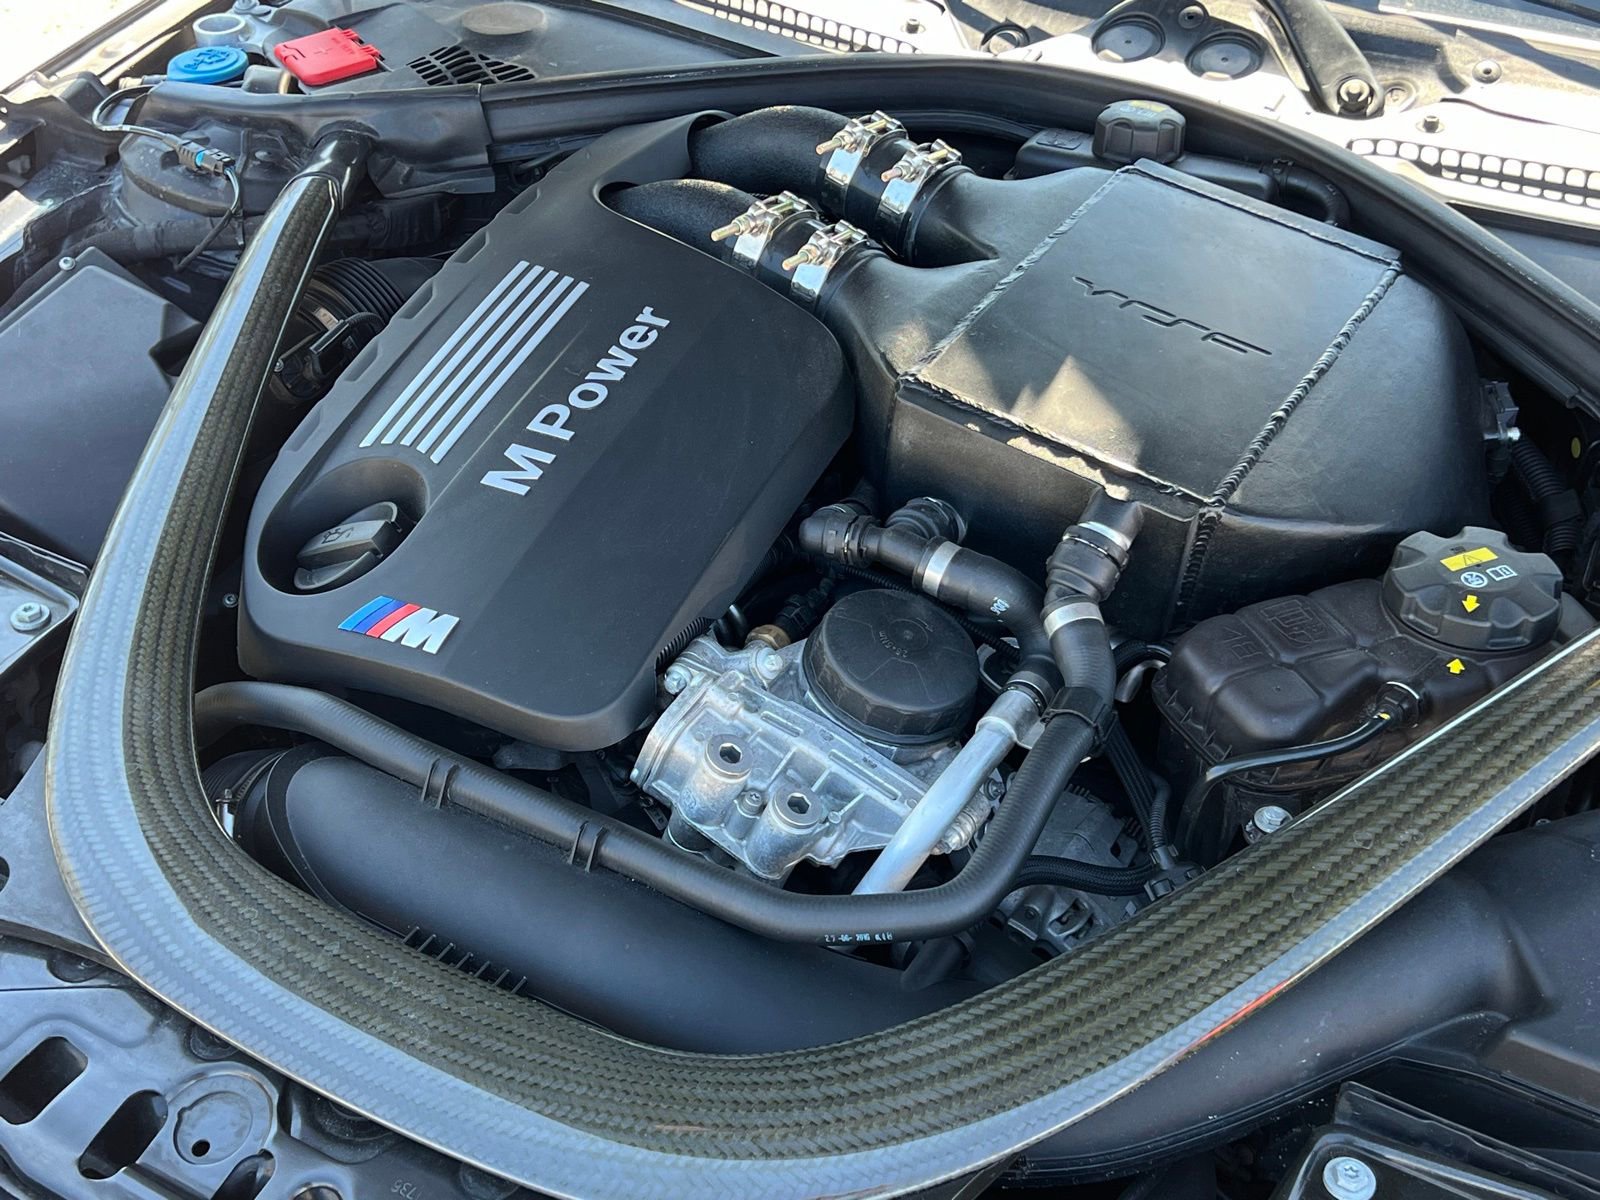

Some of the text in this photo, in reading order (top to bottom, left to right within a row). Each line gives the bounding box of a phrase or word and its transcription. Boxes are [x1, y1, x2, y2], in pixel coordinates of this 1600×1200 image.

[479, 305, 671, 497] M Power
[378, 606, 460, 655] M
